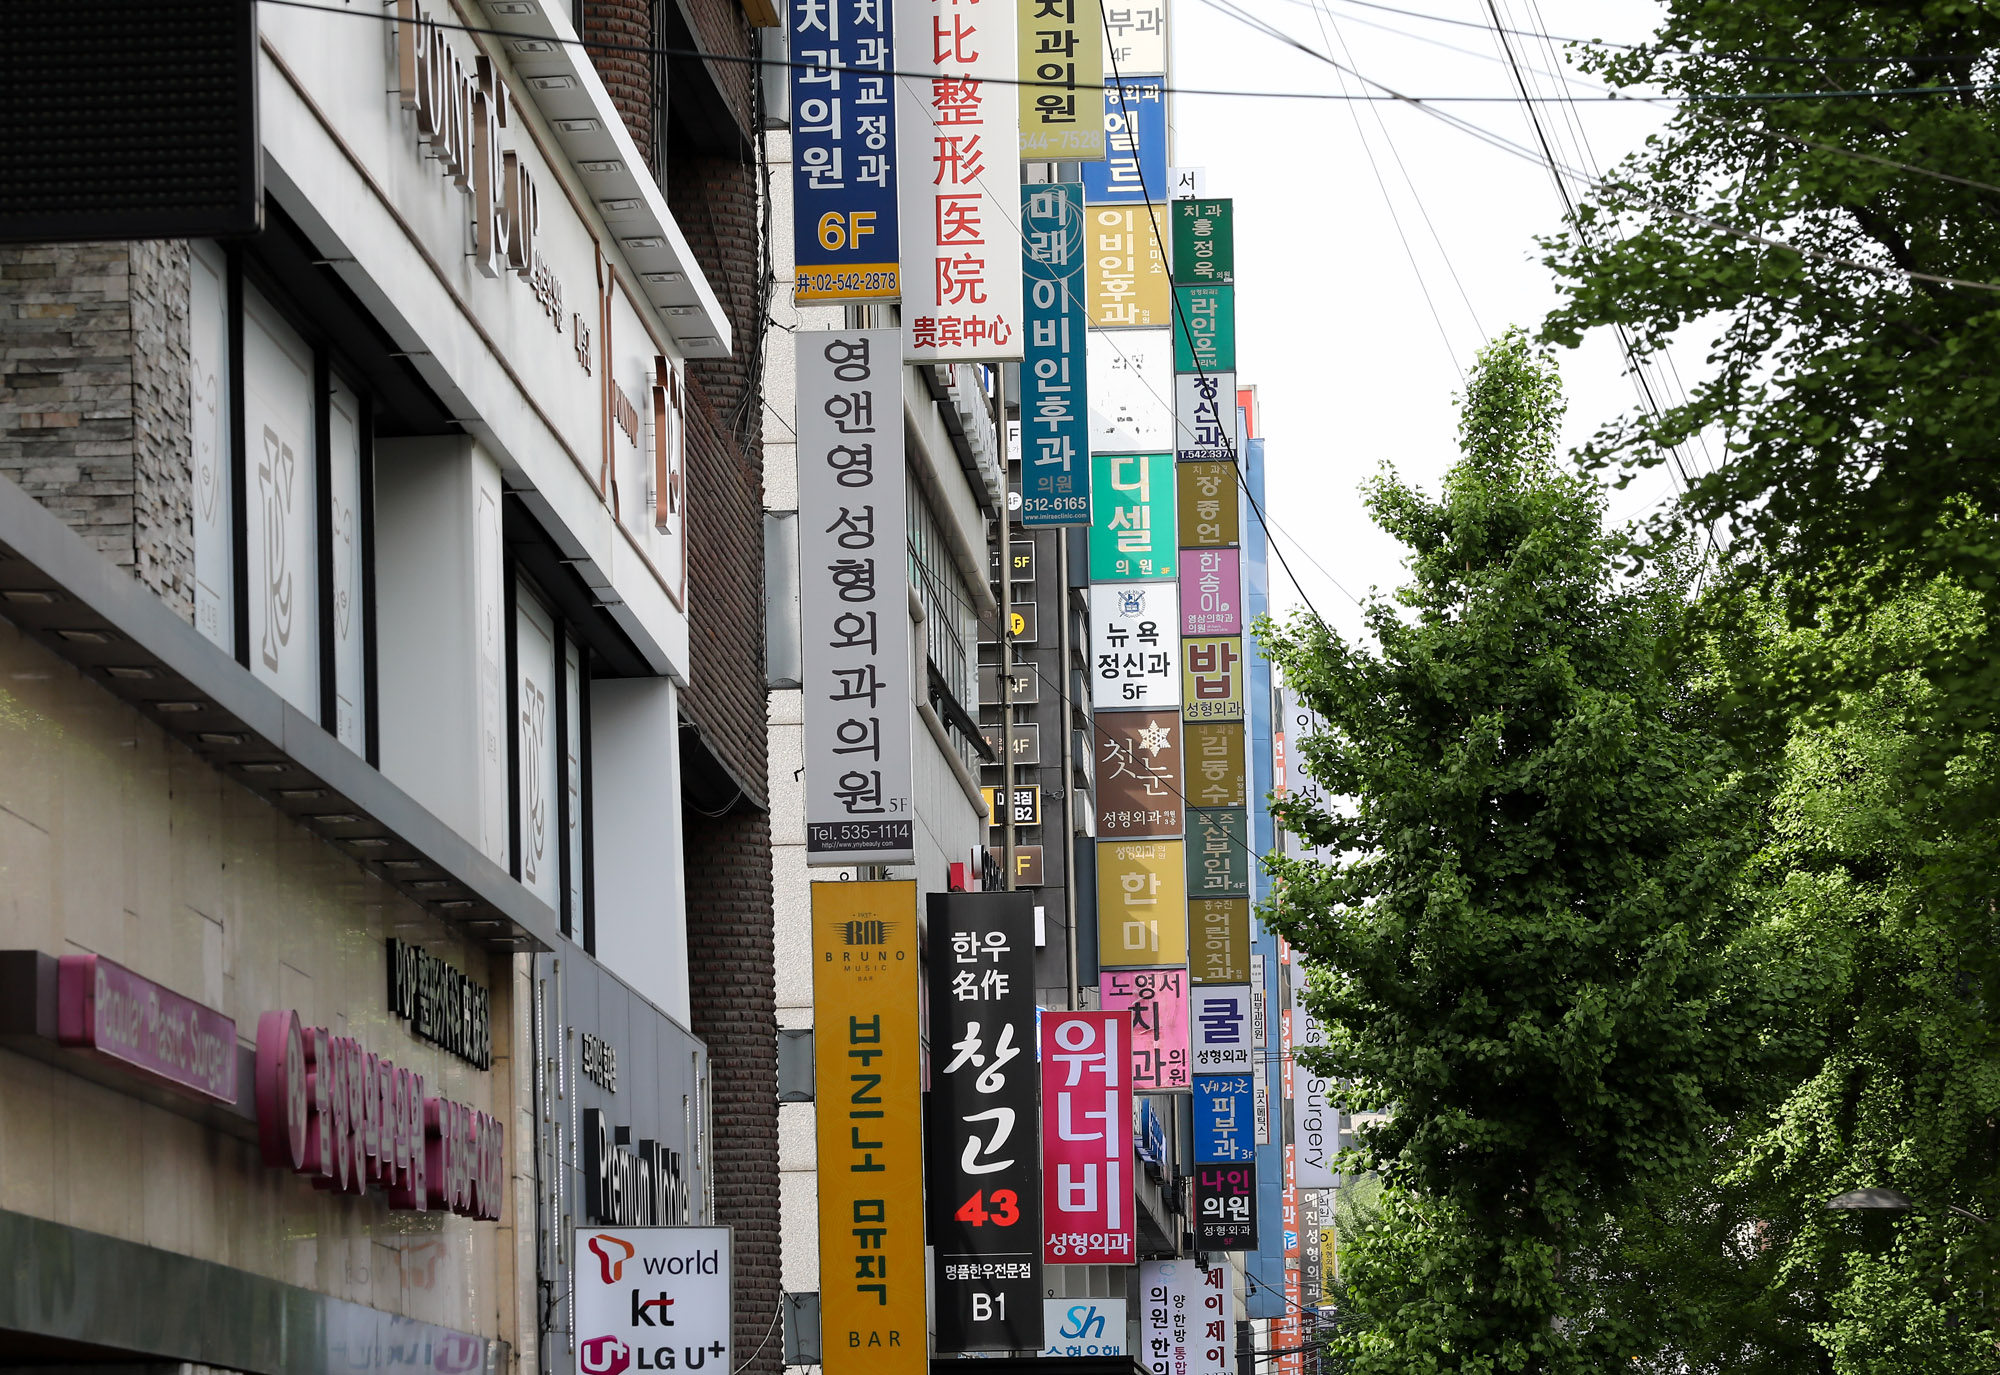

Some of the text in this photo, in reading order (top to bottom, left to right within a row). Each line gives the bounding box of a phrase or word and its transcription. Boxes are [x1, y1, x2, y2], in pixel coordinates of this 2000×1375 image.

[1111, 47, 1132, 62] 4F
[797, 0, 846, 190] 치과의원
[854, 0, 890, 188] 치과교정과
[931, 0, 987, 307] 比整形医院
[1184, 204, 1222, 218] 치과
[817, 211, 877, 251] 6F
[1097, 210, 1140, 324] 이비인후과
[912, 314, 1012, 349] 贵宾中心
[1194, 377, 1222, 448] 정신과
[1037, 475, 1072, 493] 의원
[1024, 497, 1087, 512] 512-6165
[1108, 457, 1152, 553] 디셀
[1014, 556, 1030, 568] 5F
[1115, 558, 1153, 576] 의원
[1199, 552, 1222, 612] 한송이
[1106, 620, 1159, 647] 뉴욕
[1188, 623, 1206, 633] 의원
[1098, 650, 1171, 679] 정신과
[1121, 683, 1148, 701] 5F
[1186, 701, 1242, 719] 성형외과
[1101, 738, 1174, 796] 첫눈
[1201, 736, 1230, 804] 김동수
[889, 797, 908, 813] 5F
[1103, 809, 1162, 829] 성형외과
[810, 823, 909, 841] Tel. 535-1114
[1115, 845, 1156, 860] 성형외과
[1202, 826, 1233, 890] 산부인과
[1233, 881, 1247, 889] 4F
[1120, 871, 1161, 952] 한미
[825, 951, 905, 962] BRUNO
[951, 931, 1011, 963] 한우
[1204, 913, 1235, 980] 어린이치과
[844, 964, 887, 972] MUSIC
[952, 969, 1010, 1001] 名作
[1109, 972, 1181, 999] 노영서
[1198, 998, 1244, 1044] 쿨
[1254, 992, 1264, 1040] 피부과의원
[1168, 1049, 1187, 1085] 의원
[1197, 1049, 1248, 1065] 성형외과
[1052, 1018, 1121, 1230] 워너비
[1212, 1096, 1239, 1160] 피부과
[1303, 1079, 1326, 1169] Surgery
[596, 1108, 651, 1226] Premium
[1242, 1149, 1253, 1160] 3F
[1202, 1169, 1250, 1195] 나인
[954, 1188, 1020, 1227] 43
[1202, 1196, 1250, 1221] 의원
[1046, 1232, 1131, 1257] 성형외과
[643, 1250, 718, 1276] world
[946, 1263, 1031, 1281] 명품한우전문점
[632, 1288, 675, 1327] kt
[972, 1292, 1005, 1322] B1
[1059, 1305, 1106, 1339] Sh
[1204, 1267, 1225, 1368] 제이제이
[849, 1330, 901, 1348] BAR
[638, 1341, 726, 1371] LG U+
